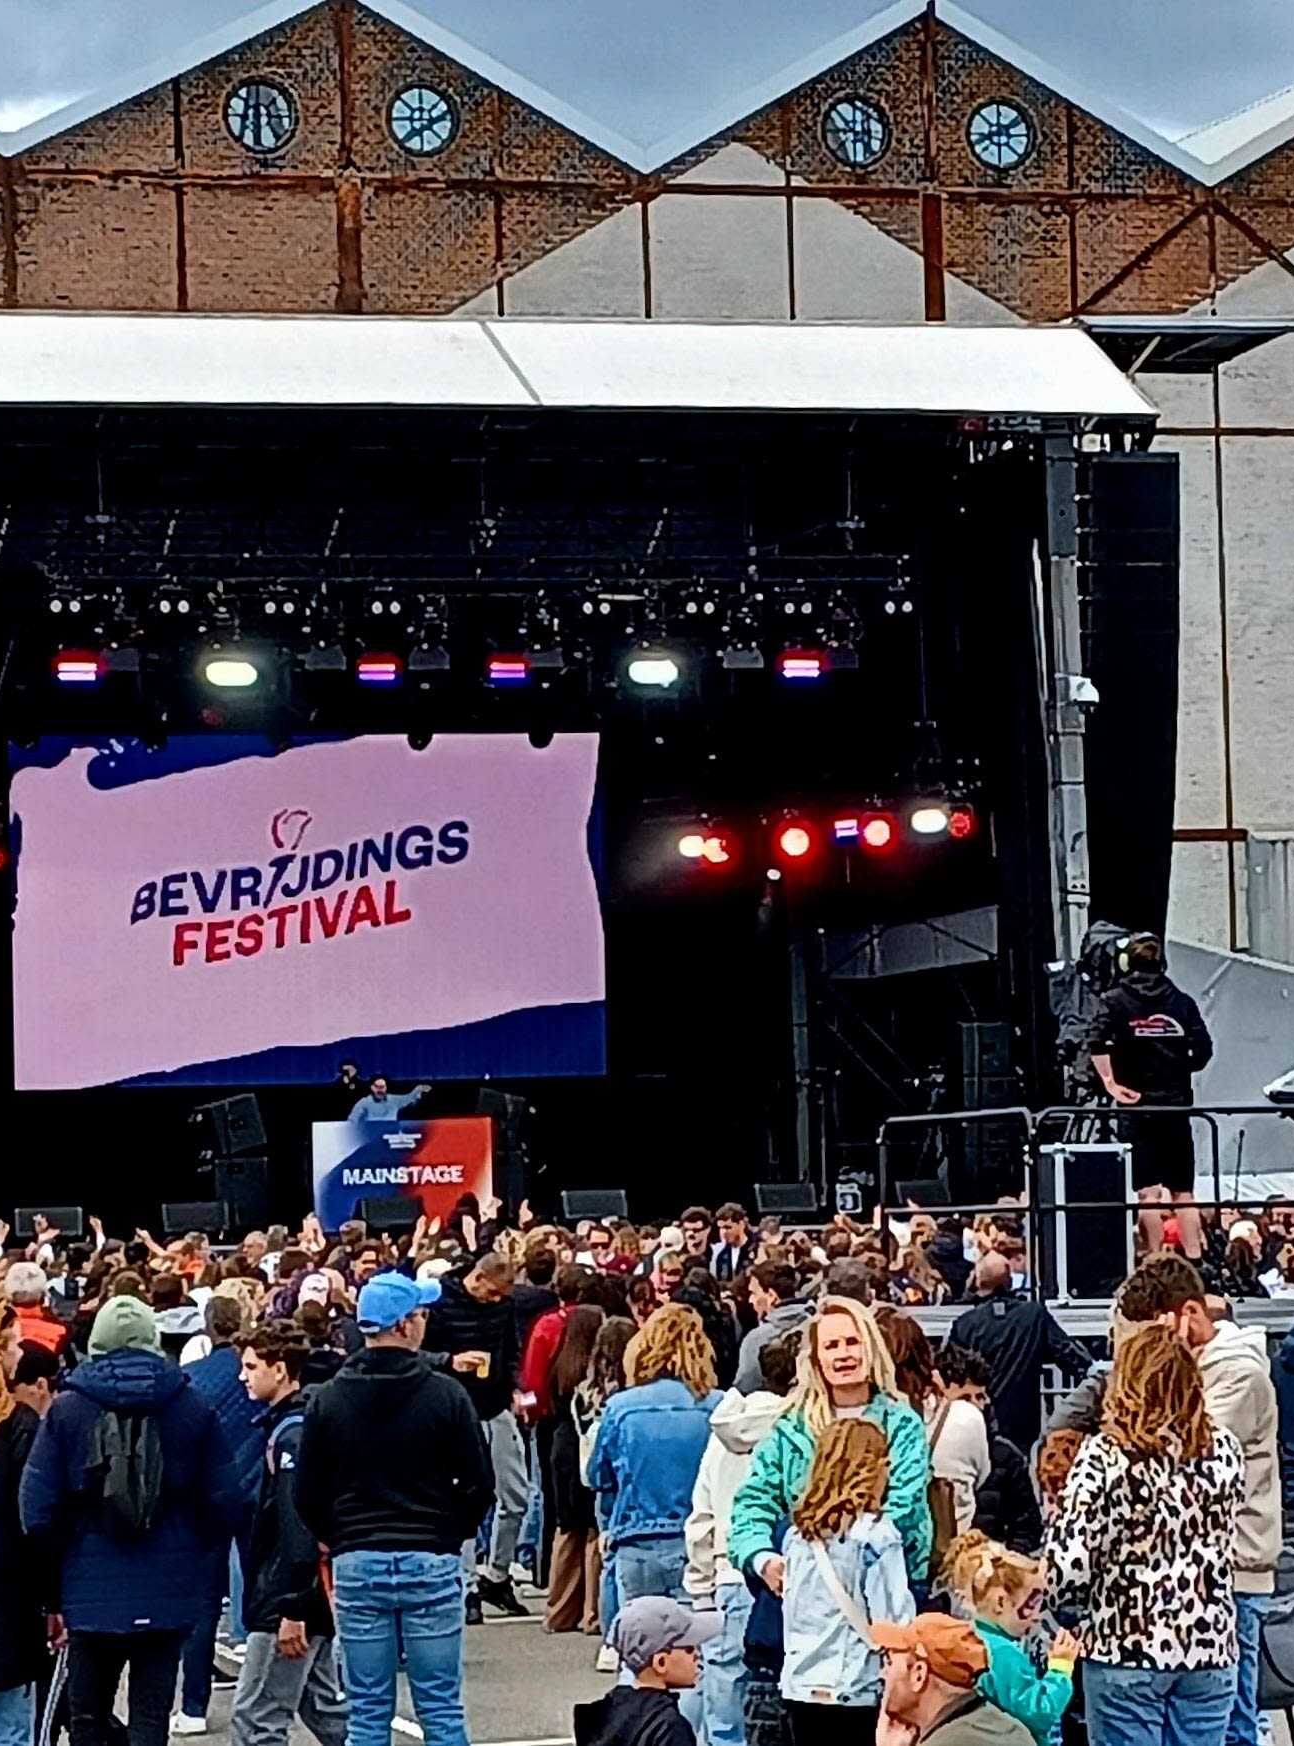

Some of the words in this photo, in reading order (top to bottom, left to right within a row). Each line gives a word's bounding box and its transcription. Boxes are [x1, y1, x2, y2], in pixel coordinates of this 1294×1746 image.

[130, 821, 470, 926] BEVRIJDINGS
[172, 880, 412, 966] FESTIVAL
[343, 1165, 464, 1185] MAINSTAGE
